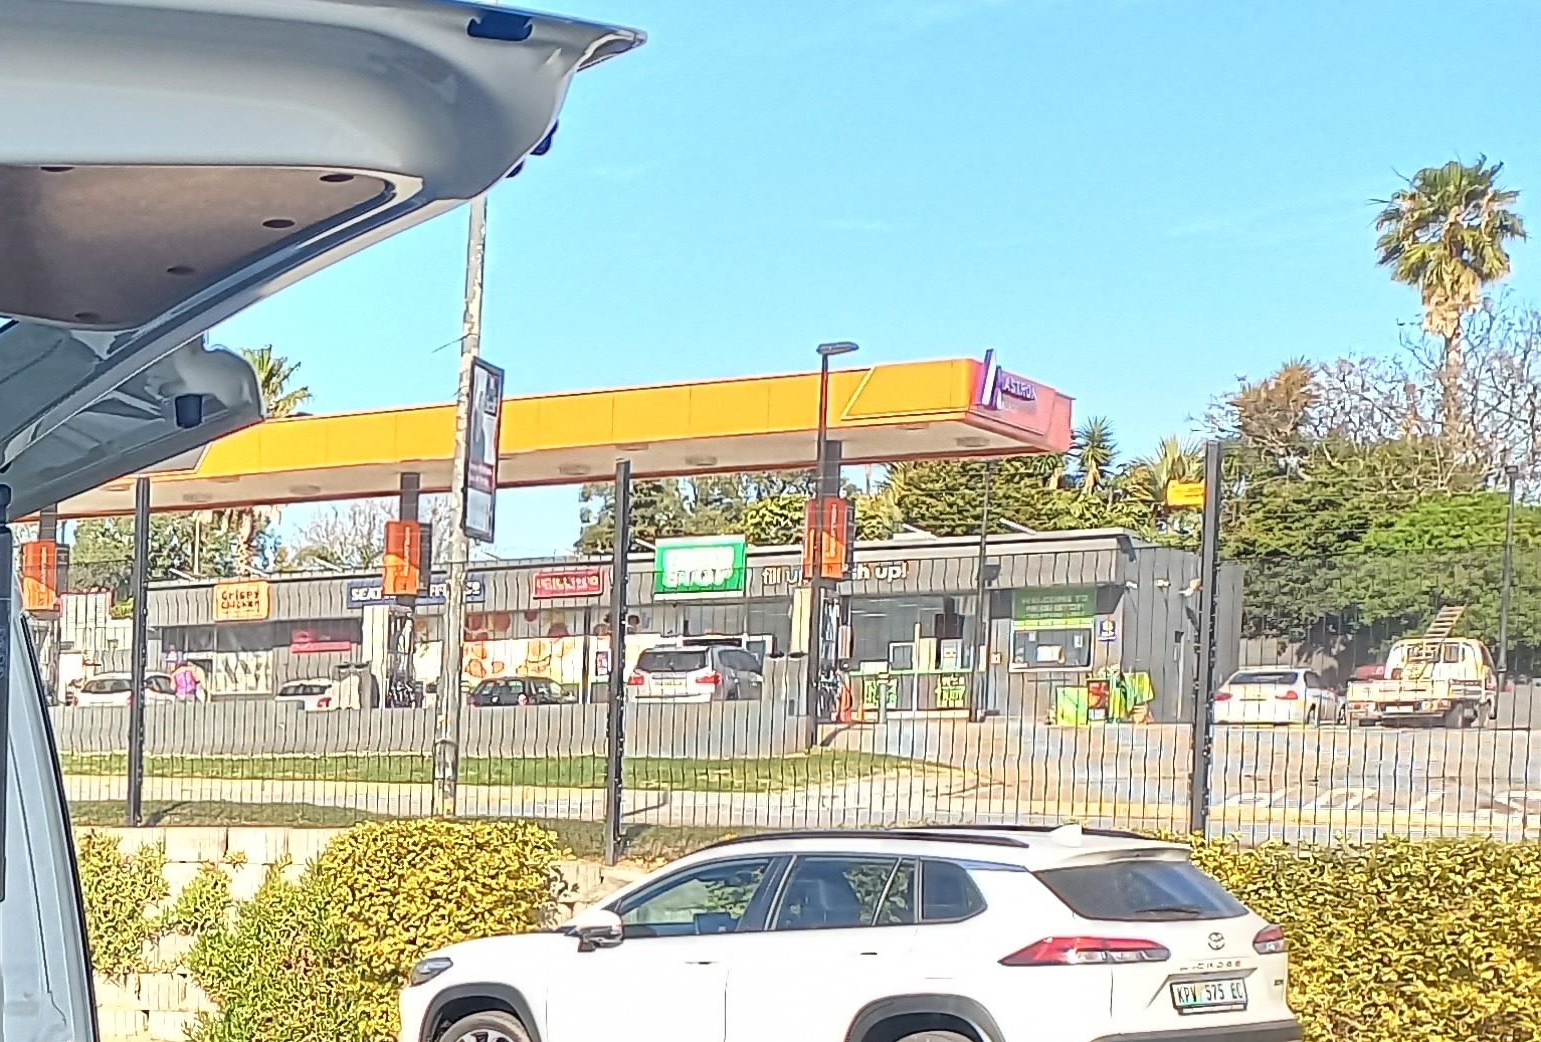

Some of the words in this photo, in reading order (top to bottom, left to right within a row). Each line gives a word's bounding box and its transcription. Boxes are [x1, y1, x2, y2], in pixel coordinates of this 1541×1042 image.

[761, 565, 782, 585] fill
[875, 562, 907, 582] up!
[1177, 984, 1197, 1003] KPV
[1204, 983, 1225, 1001] 575
[1230, 981, 1243, 999] EC
